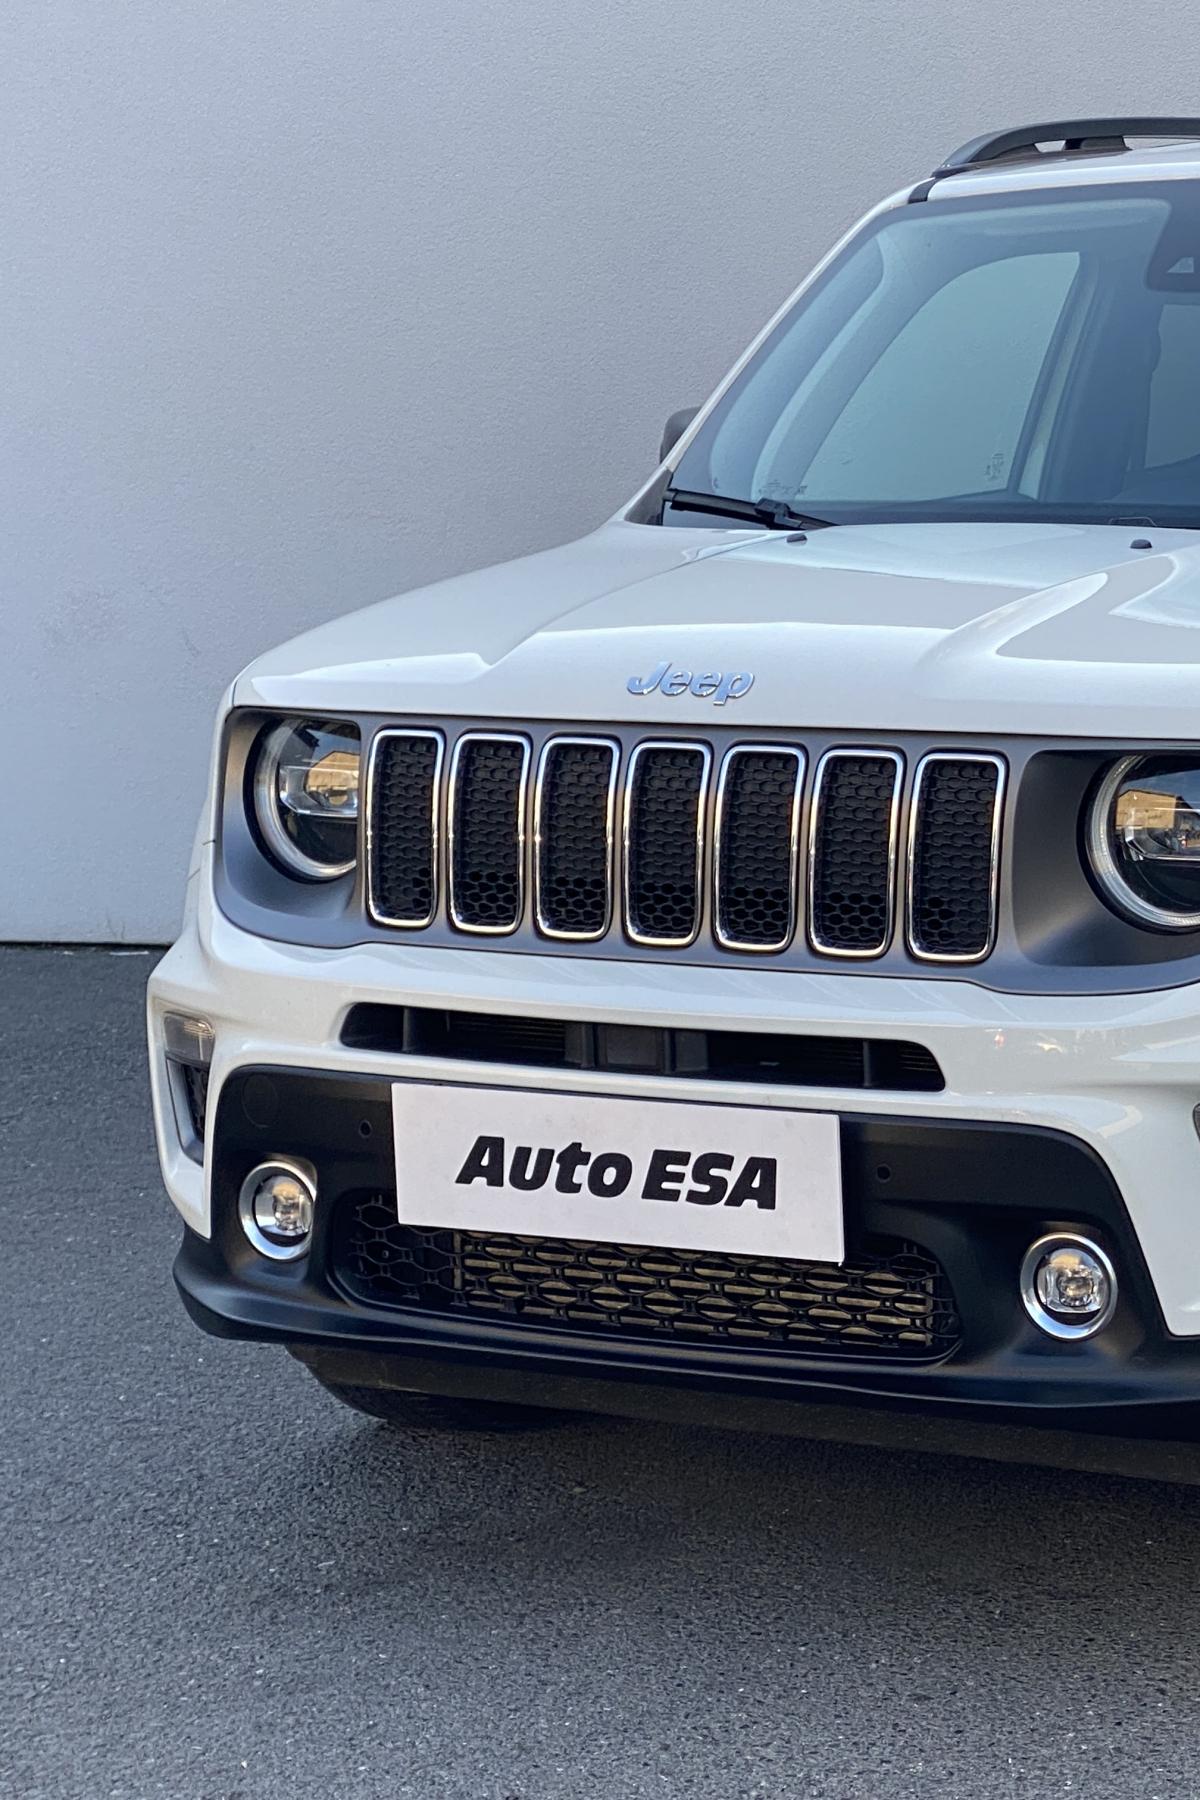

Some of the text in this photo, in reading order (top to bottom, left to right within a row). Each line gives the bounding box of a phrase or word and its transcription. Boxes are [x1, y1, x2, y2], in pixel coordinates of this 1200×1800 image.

[627, 661, 755, 706] Jeep
[455, 1135, 777, 1211] Auto ESA
